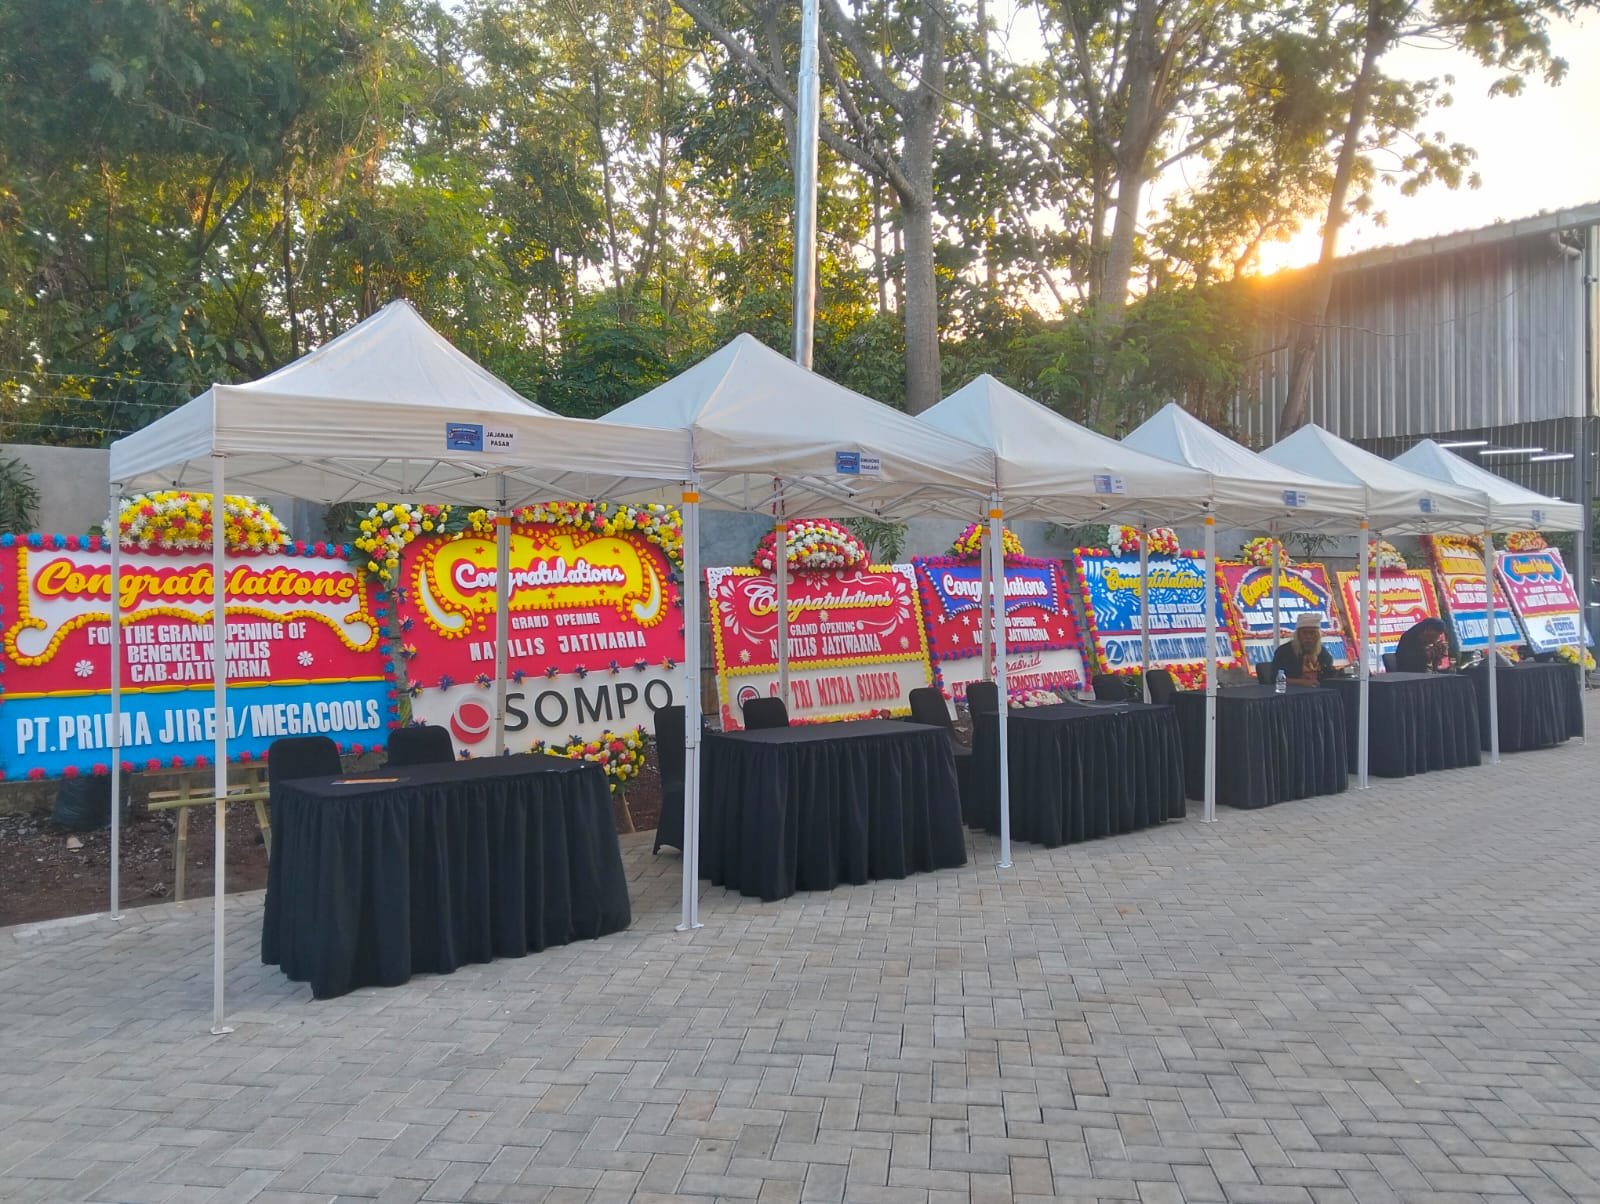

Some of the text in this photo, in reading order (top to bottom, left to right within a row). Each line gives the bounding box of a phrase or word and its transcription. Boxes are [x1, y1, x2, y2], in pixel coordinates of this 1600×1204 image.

[486, 431, 513, 439] JAJANAN
[511, 612, 601, 630] GRAND OPENING
[790, 621, 856, 636] GRAND OPENING
[88, 622, 306, 645] FO THE GRAND PENING OF
[558, 630, 647, 653] JATIWARNA
[1008, 628, 1050, 642] JATIWARNA
[127, 641, 271, 664] BENGKEL NWILIS
[469, 637, 546, 661] NAILIS
[769, 633, 882, 659] NWILIS JATIWARNA
[130, 660, 271, 682] CAB.JATIARNA
[1041, 669, 1080, 688] INDONESIA
[790, 679, 813, 709] TRI
[816, 675, 855, 707] MITRA
[856, 671, 900, 702] SUKSES
[503, 679, 673, 731] SOMPO
